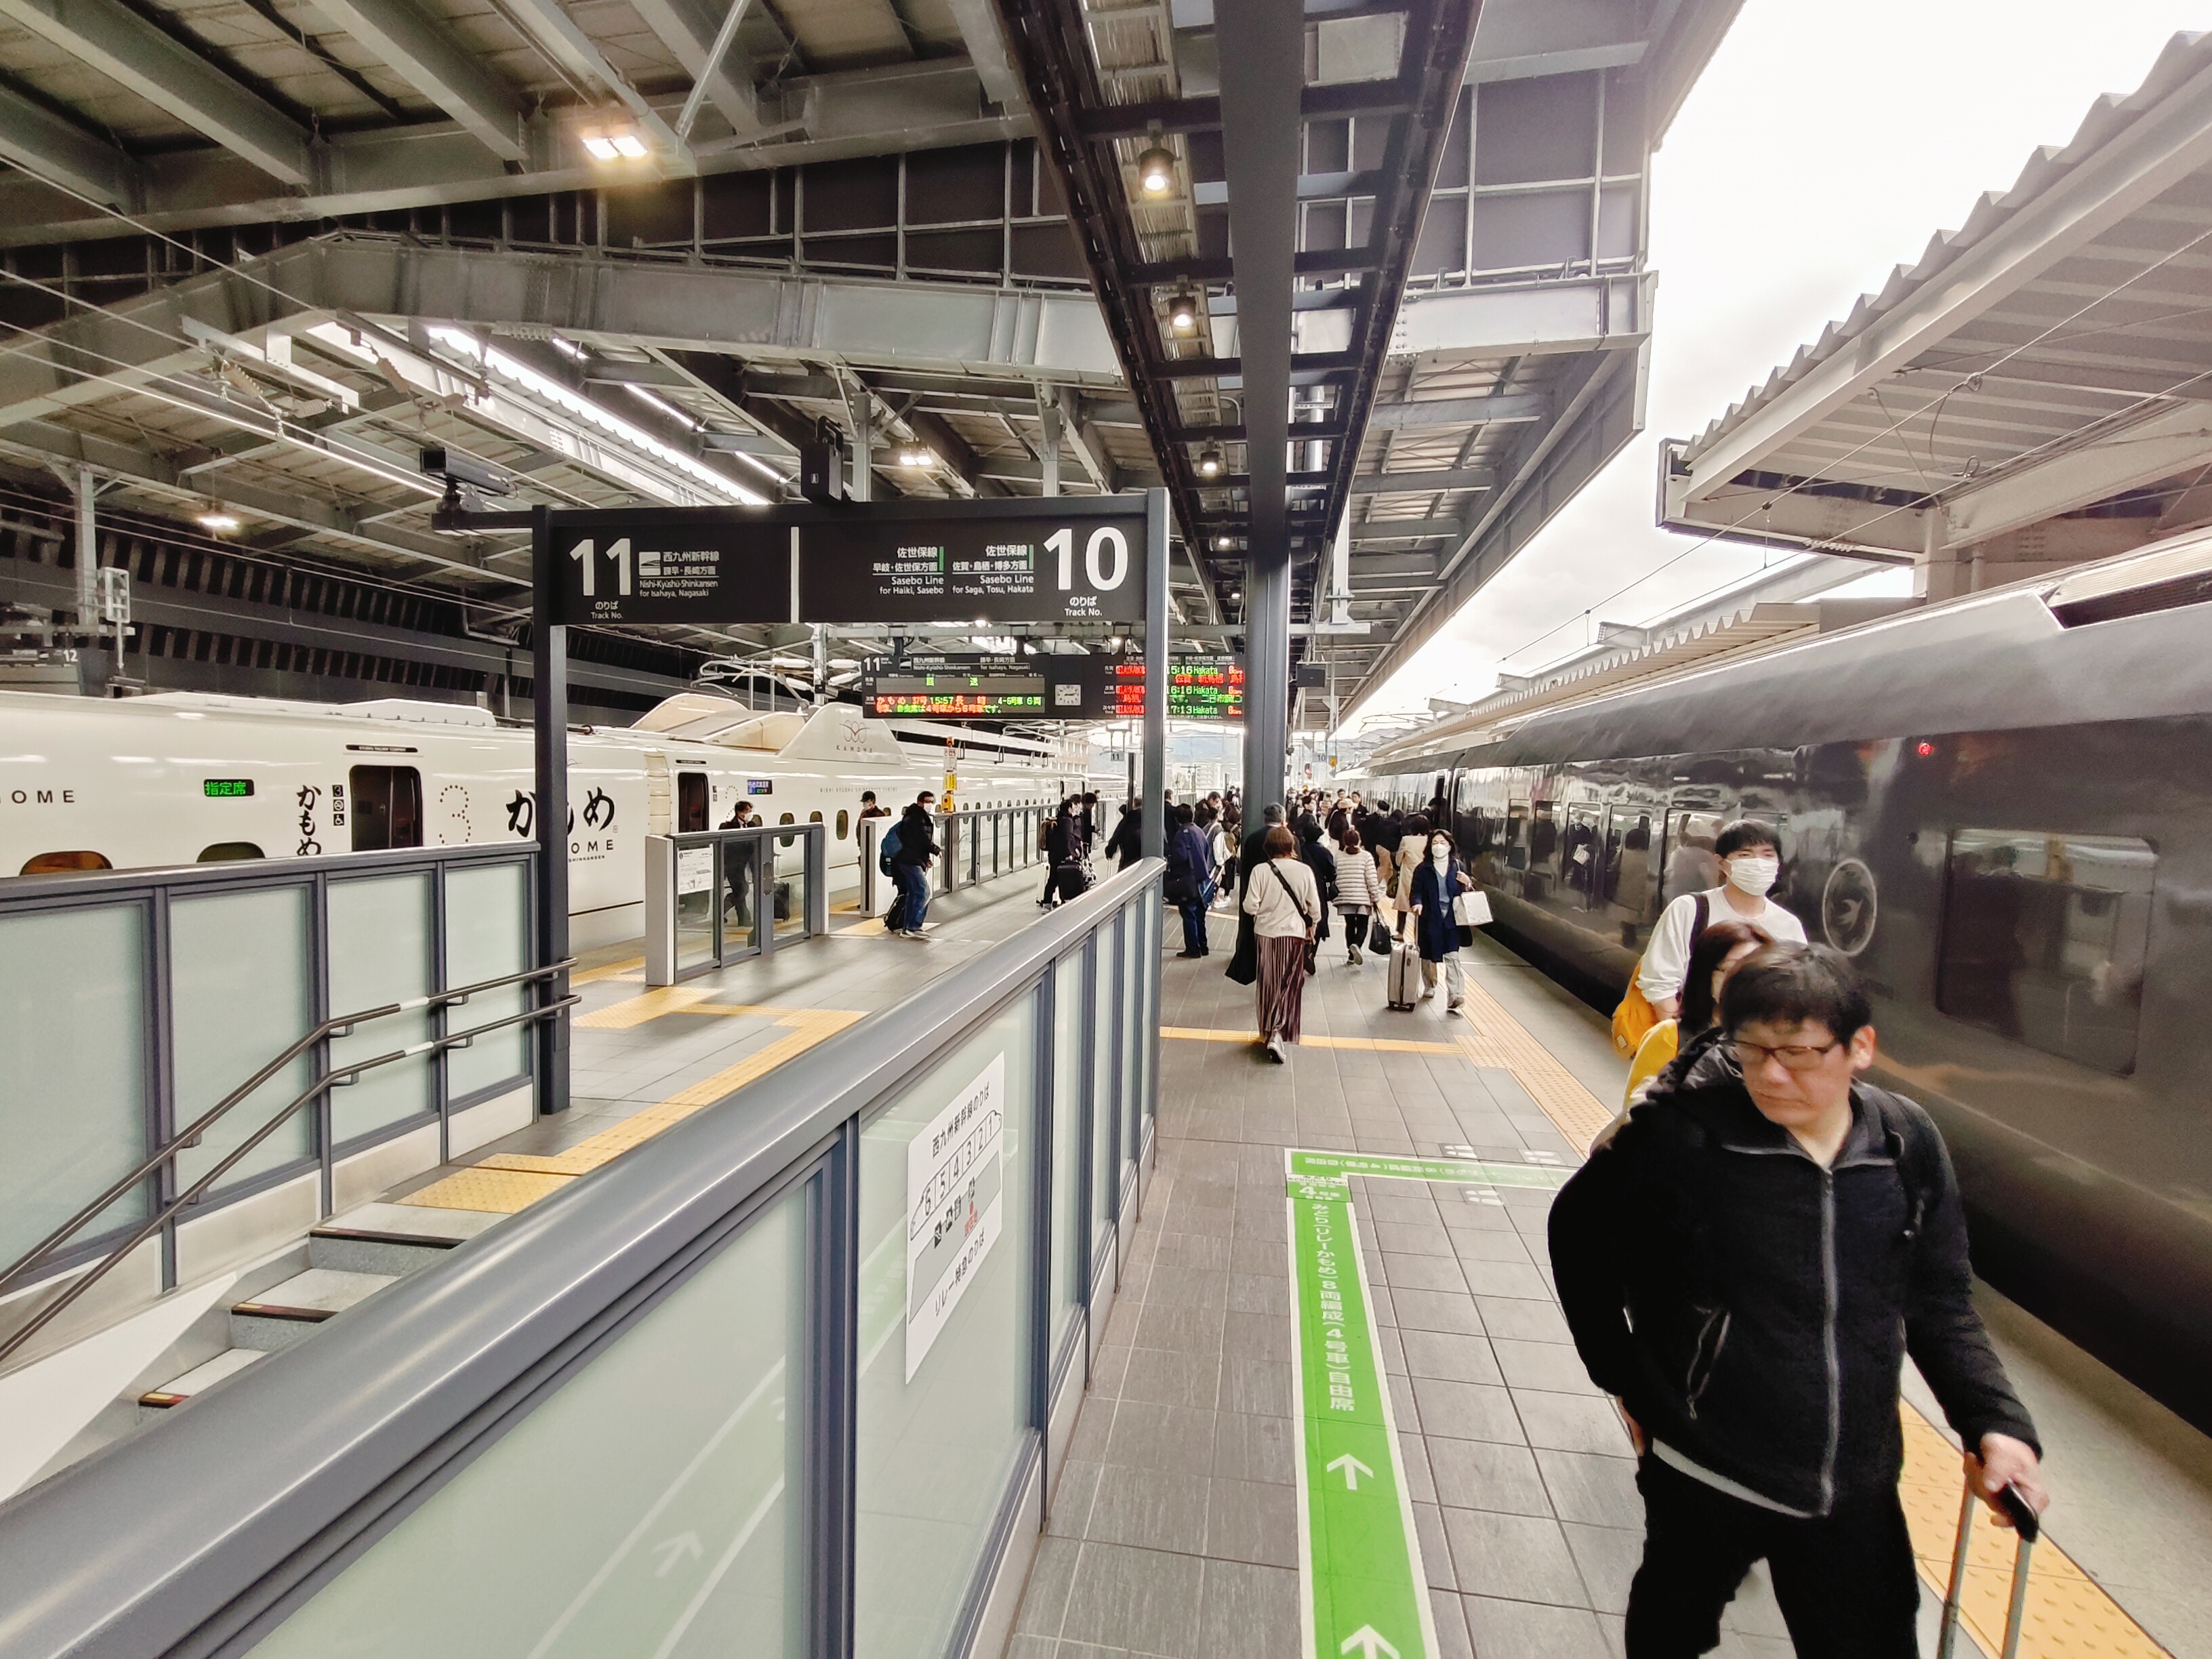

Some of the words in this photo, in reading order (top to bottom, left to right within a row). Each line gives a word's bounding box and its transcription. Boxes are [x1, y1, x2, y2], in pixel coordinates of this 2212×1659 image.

[897, 546, 938, 558] 佐世保線
[985, 544, 1027, 557] 佐世保線
[1044, 527, 1128, 591] 10
[569, 537, 631, 596] 11
[891, 576, 922, 585] Sasebo
[925, 575, 944, 584] Line
[979, 574, 1012, 584] Sasebo
[1015, 574, 1034, 583] Line
[651, 590, 677, 598] Isahaya,
[678, 590, 709, 598] Nagasaki
[880, 586, 891, 594] for
[893, 586, 915, 595] Haiki,
[916, 586, 944, 594] Sasebo
[952, 585, 964, 594] for
[964, 585, 985, 595] Saga,
[986, 585, 1005, 594] Tosu,
[1007, 585, 1034, 594] Hakata
[595, 600, 619, 609] のりば
[1069, 596, 1097, 606] のりば
[1064, 607, 1086, 616] Track
[1088, 607, 1103, 616] No.
[63, 650, 79, 661] 12
[863, 657, 880, 671] 11
[1194, 666, 1218, 674] Hakata
[1193, 686, 1218, 695] Hakata
[1193, 705, 1218, 714] Hakata
[1317, 754, 1326, 762] 10
[205, 781, 246, 796] 指定席
[0, 790, 75, 804] OME
[506, 786, 615, 838] かめ
[296, 784, 322, 856] かもめ
[932, 1081, 989, 1160] 西九州新幹線のりば
[924, 1187, 931, 1216] 6
[939, 1170, 945, 1200] 5
[953, 1153, 960, 1179] 4
[966, 1140, 972, 1166] 3
[978, 1127, 983, 1151] 2
[988, 1115, 992, 1137] 1
[935, 1227, 985, 1317] リレー特急のりば
